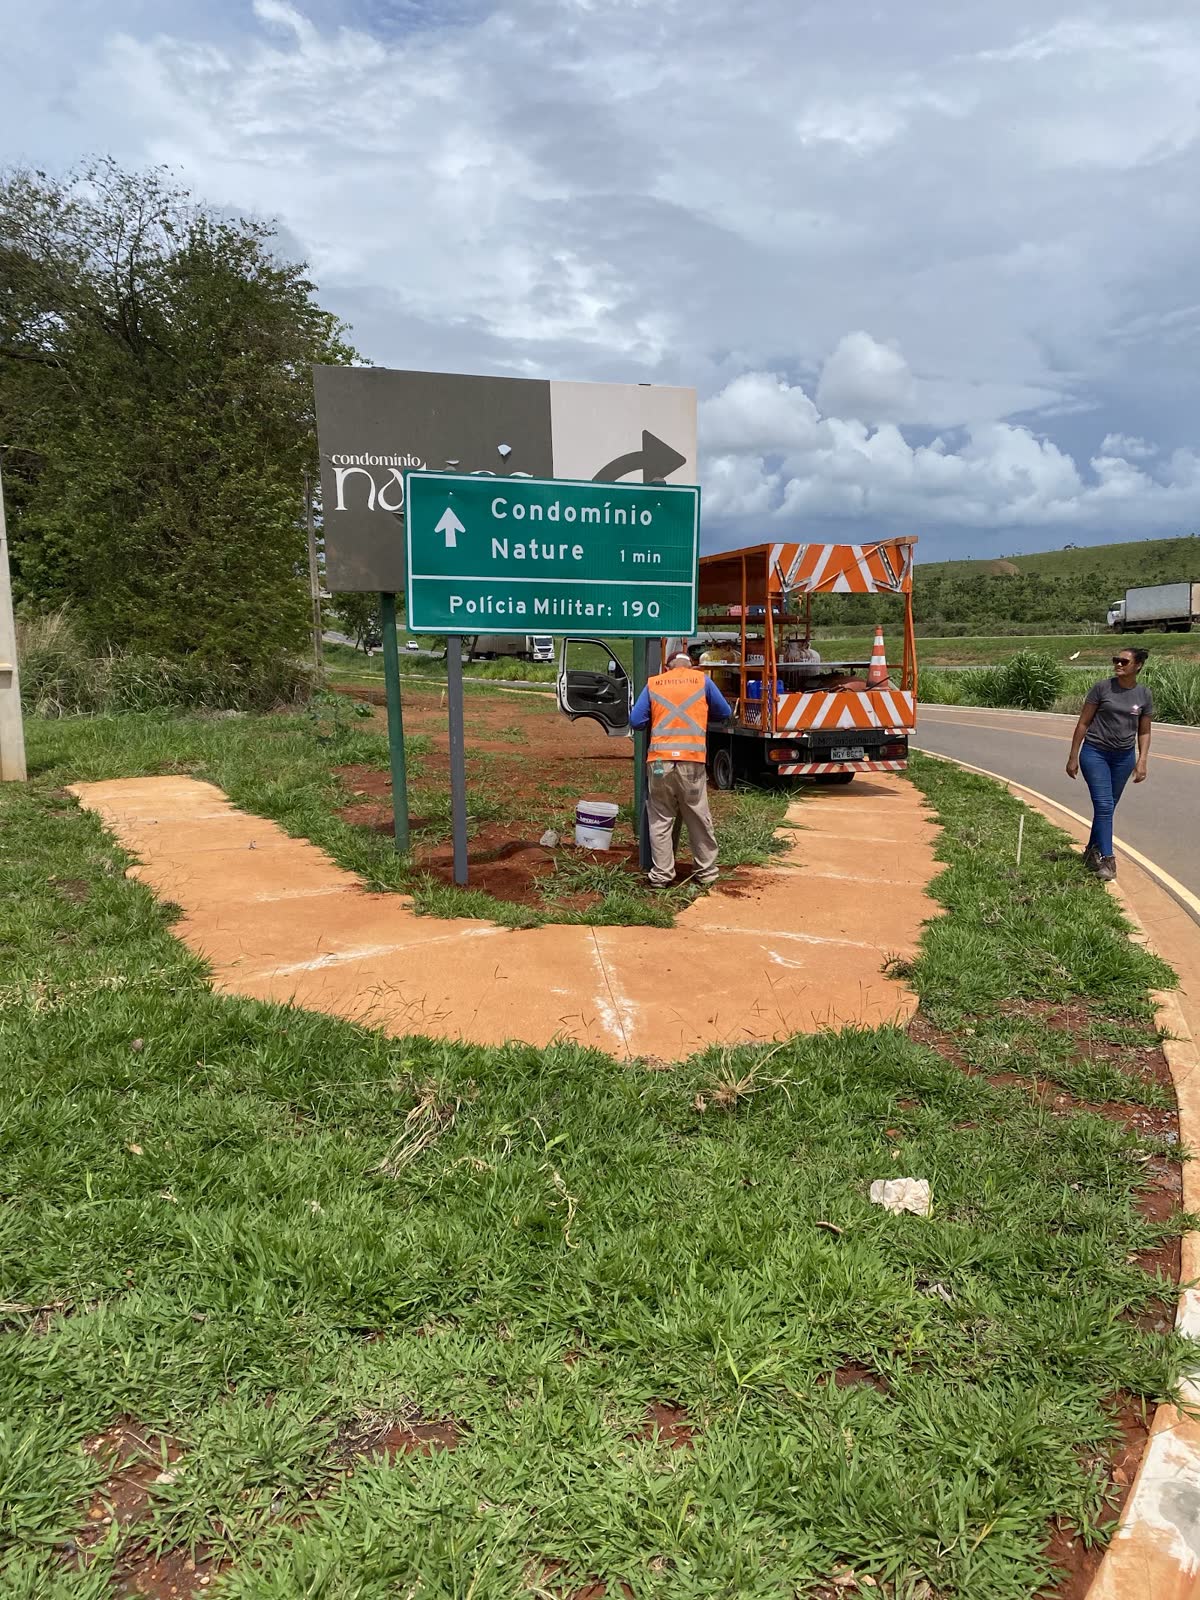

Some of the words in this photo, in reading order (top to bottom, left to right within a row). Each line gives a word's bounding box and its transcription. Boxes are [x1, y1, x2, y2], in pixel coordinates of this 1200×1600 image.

[331, 452, 421, 466] condomínio
[491, 497, 653, 526] Condomínio
[491, 538, 584, 560] Nature
[620, 549, 625, 563] 1
[632, 549, 661, 564] min
[449, 595, 527, 614] Polícia
[533, 597, 612, 617] Militar:
